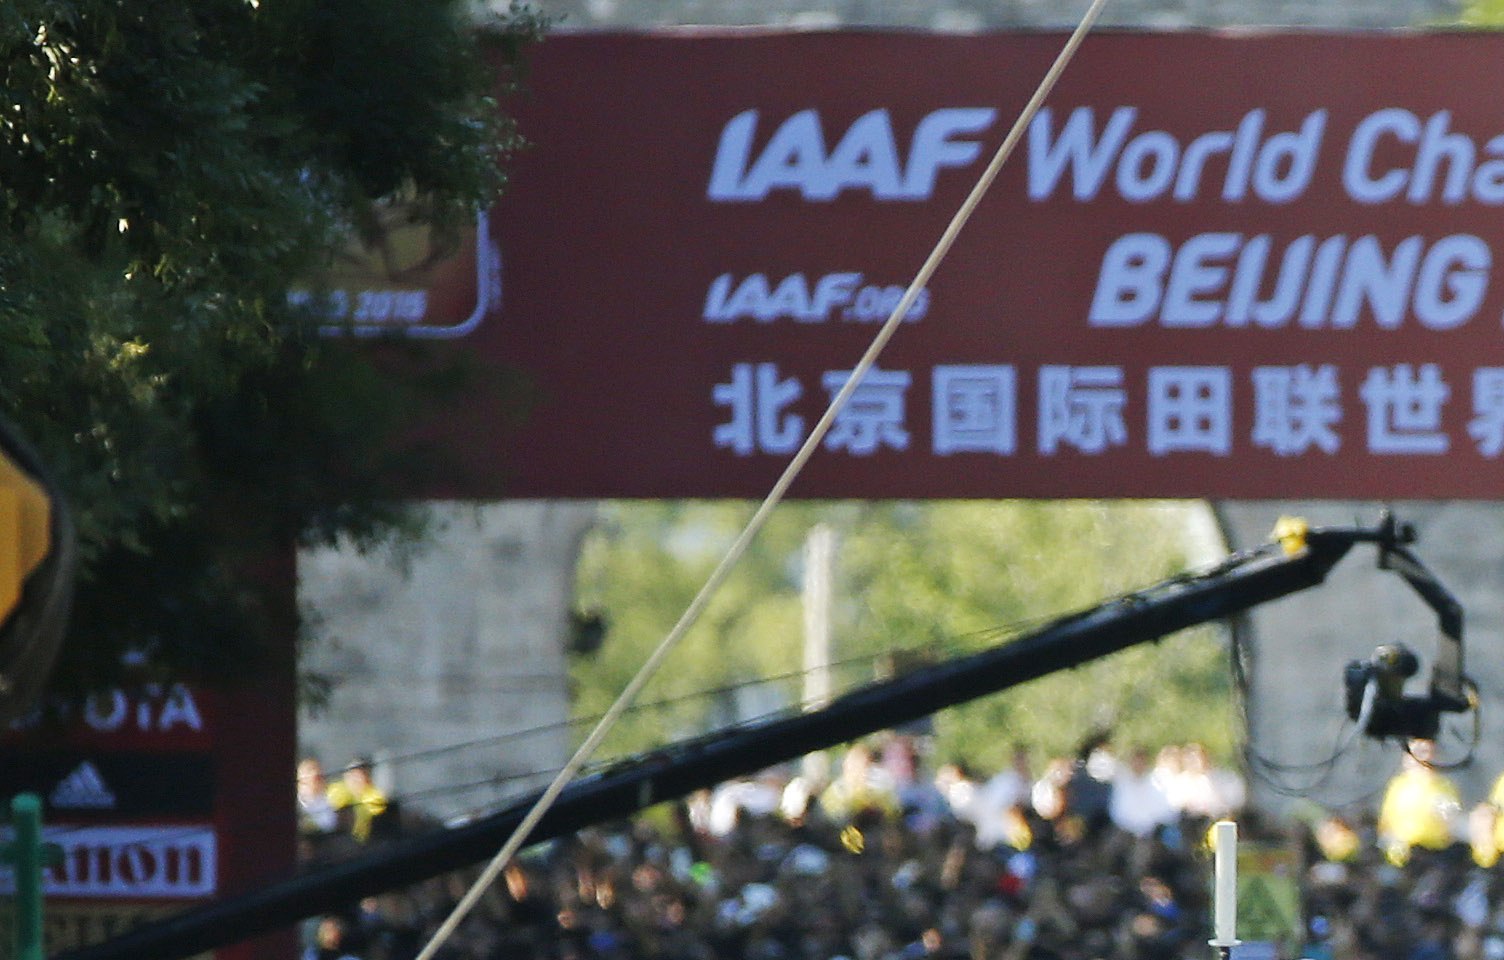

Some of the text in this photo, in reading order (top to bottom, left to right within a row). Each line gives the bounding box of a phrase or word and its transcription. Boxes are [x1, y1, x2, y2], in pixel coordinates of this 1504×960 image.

[705, 106, 997, 200] IAAF
[1026, 105, 1328, 202] World
[1088, 232, 1493, 330] BEIJING
